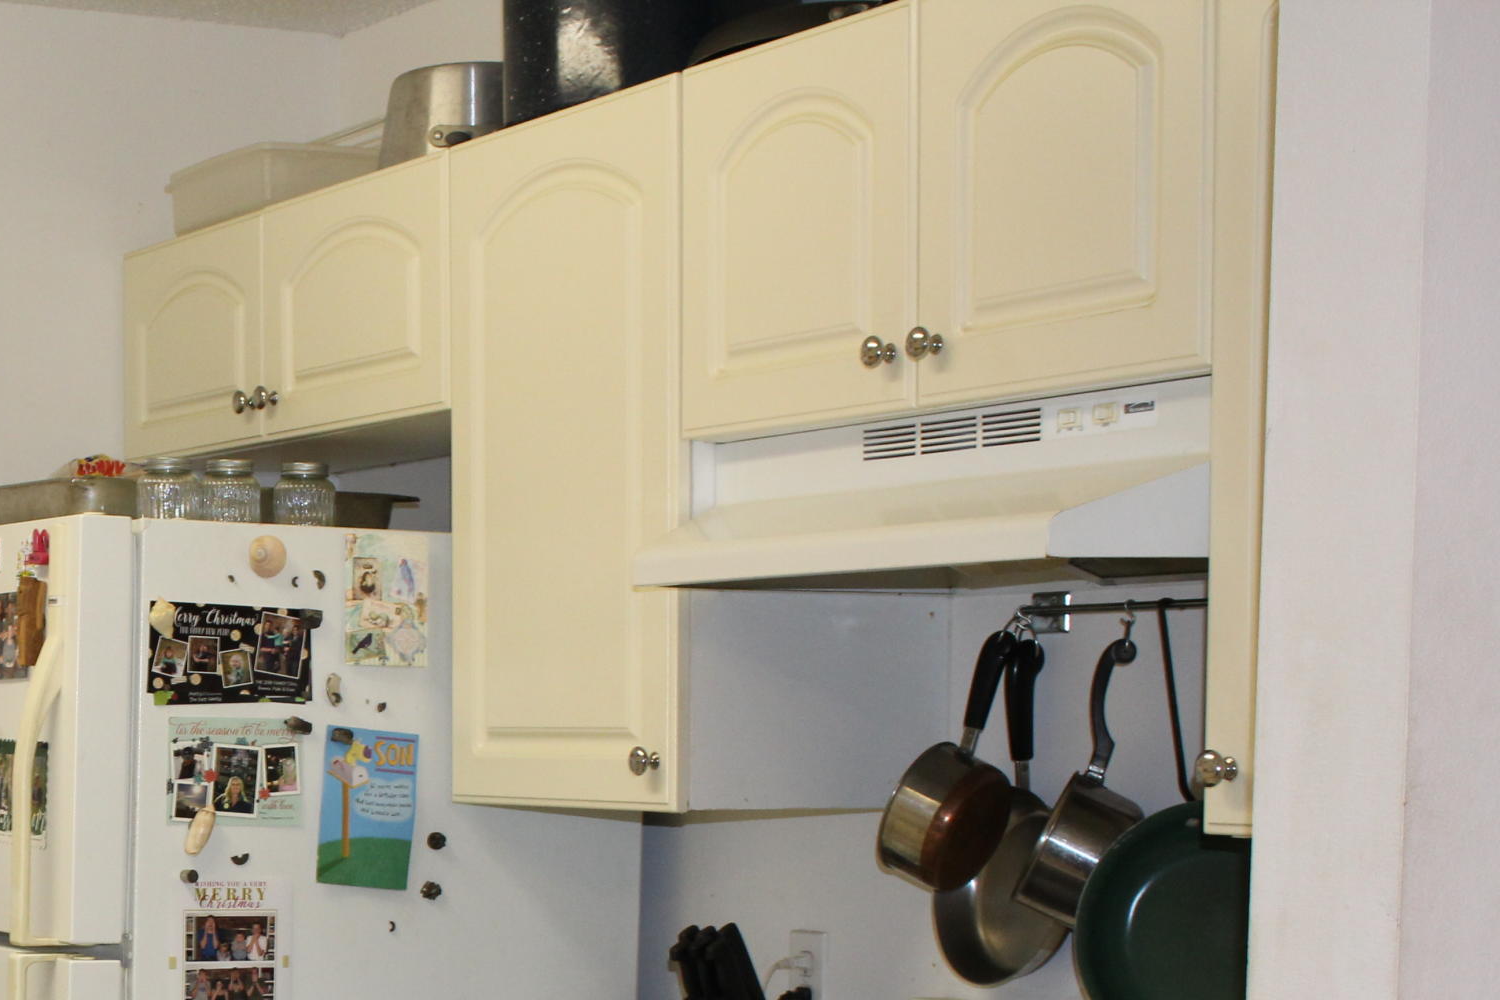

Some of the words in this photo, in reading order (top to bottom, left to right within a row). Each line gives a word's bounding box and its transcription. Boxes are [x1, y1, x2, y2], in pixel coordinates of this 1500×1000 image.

[205, 607, 257, 627] Christmas
[206, 727, 239, 735] season
[373, 741, 414, 766] SON
[195, 887, 266, 901] MERRY
[199, 895, 261, 909] Christmas
